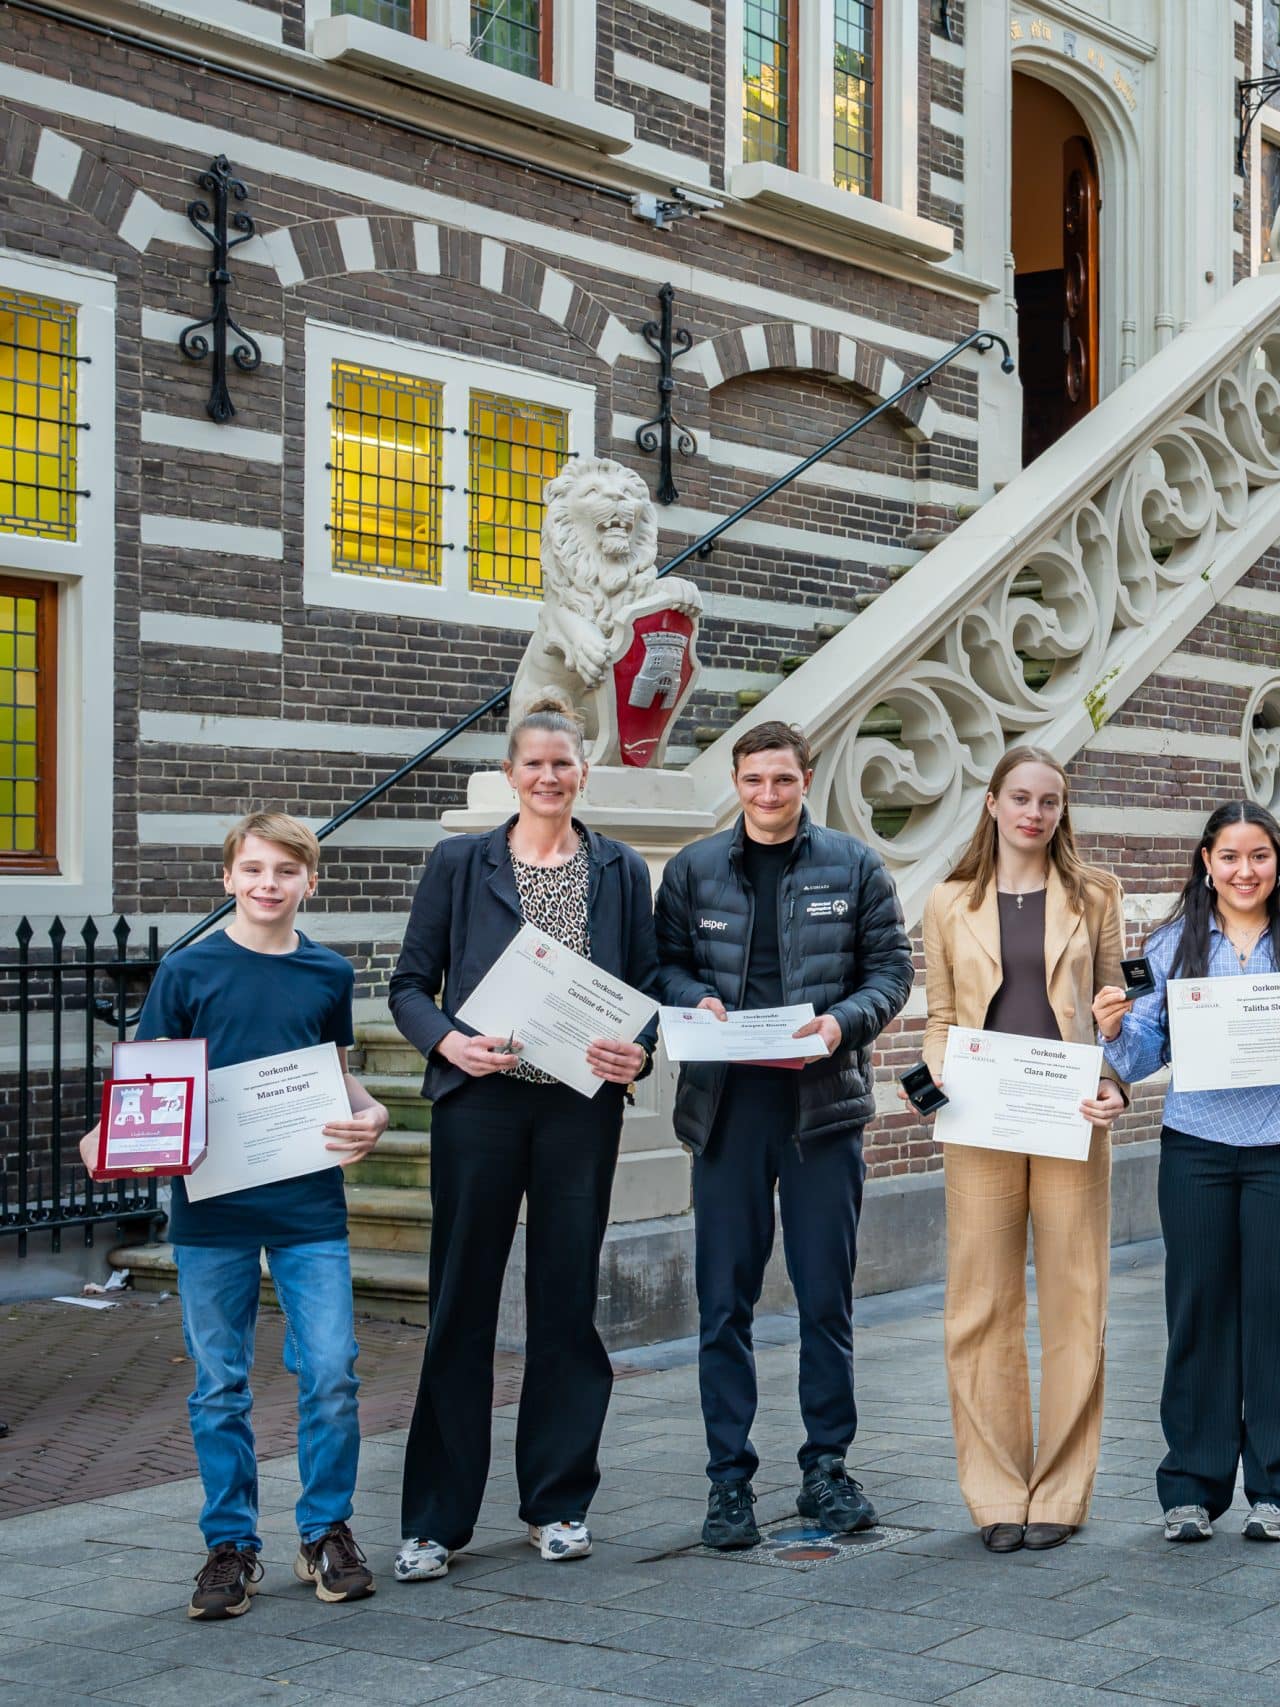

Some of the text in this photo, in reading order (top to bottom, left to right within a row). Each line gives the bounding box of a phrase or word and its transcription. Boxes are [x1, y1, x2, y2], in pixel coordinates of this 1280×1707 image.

[699, 917, 729, 931] Jesper
[591, 978, 624, 1001] Oorkonde
[567, 987, 623, 1024] Caroline de Vries
[1243, 1004, 1270, 1013] Talitha
[1030, 1048, 1067, 1060] Oorkonde
[258, 1063, 299, 1078] Oorkonde
[1024, 1067, 1068, 1080] Clara Rooze
[256, 1087, 285, 1100] Maran
[286, 1081, 310, 1093] Engel
